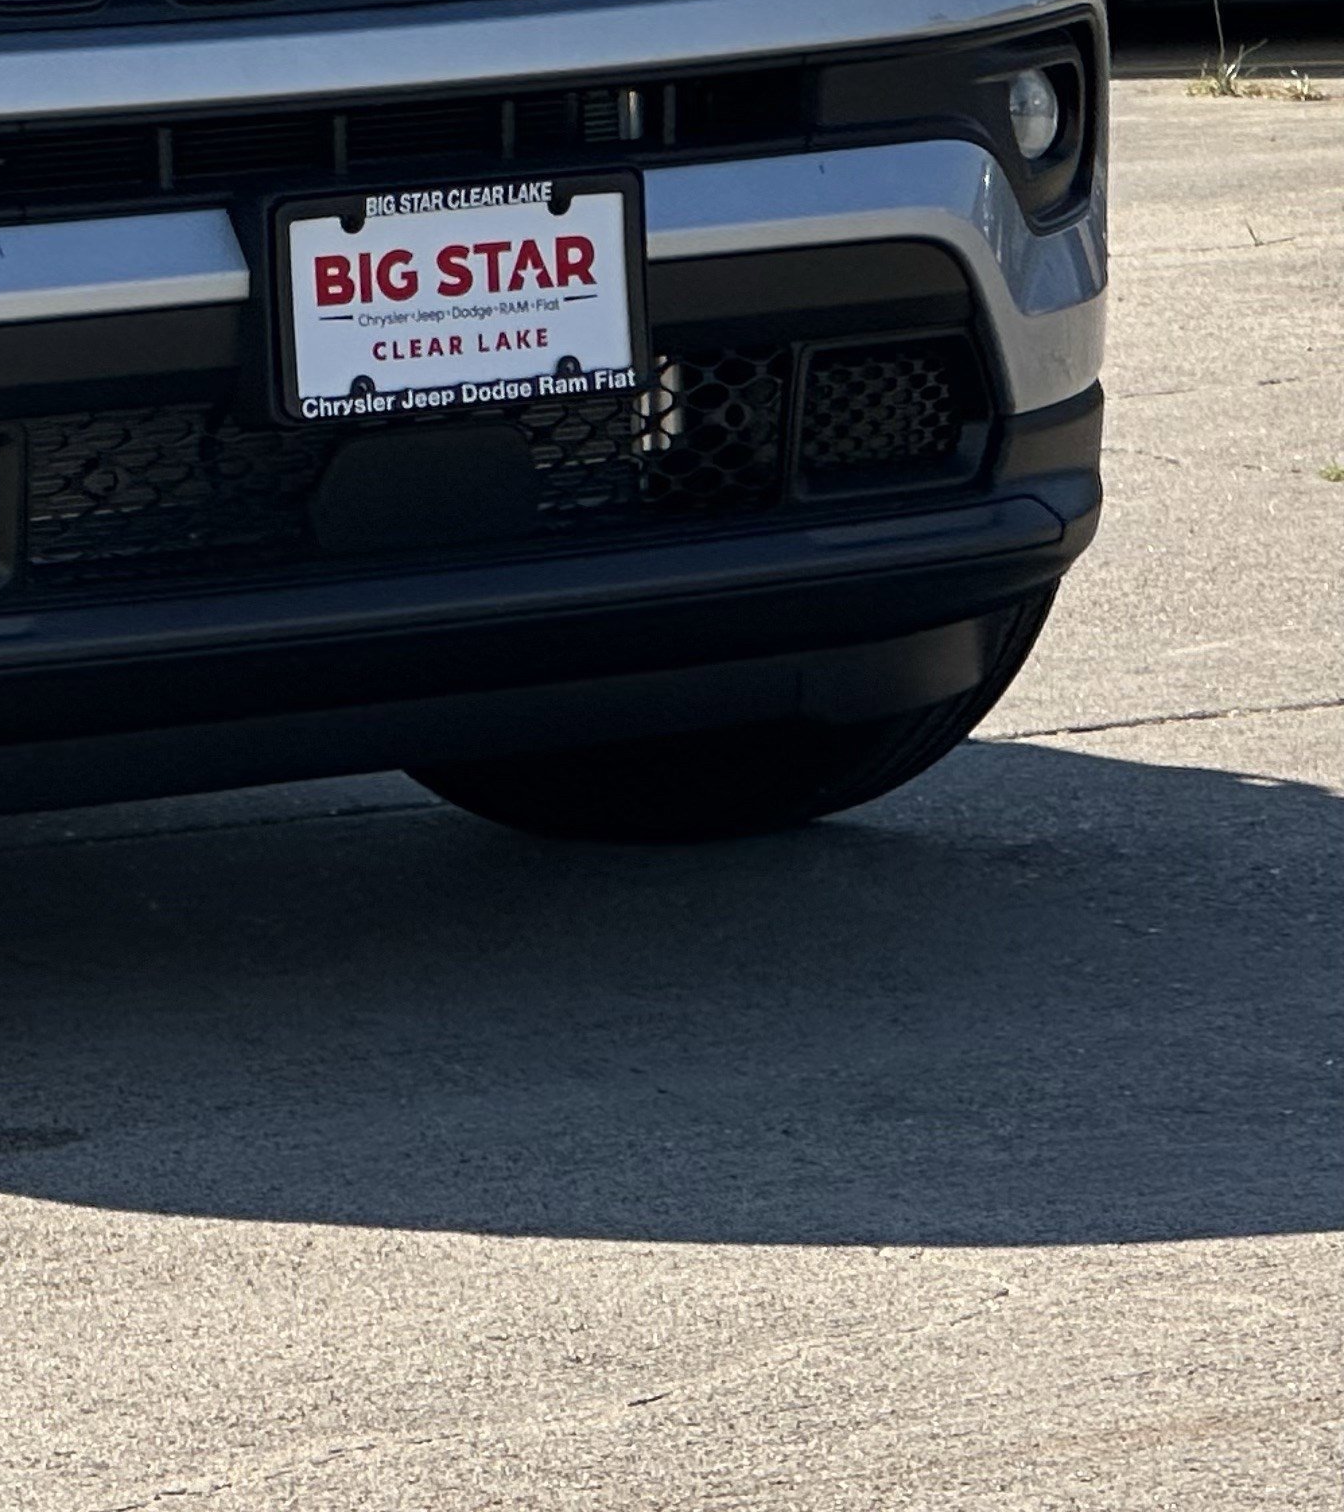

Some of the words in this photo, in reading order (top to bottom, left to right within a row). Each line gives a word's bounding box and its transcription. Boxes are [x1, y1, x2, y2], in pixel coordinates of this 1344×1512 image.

[365, 194, 397, 217] BIG
[399, 190, 444, 214] STAR
[447, 185, 505, 211] CLEAR
[507, 180, 554, 205] LAKE
[314, 248, 419, 307] BIG
[436, 235, 599, 299] STAR
[372, 334, 464, 361] CLEAR
[477, 327, 549, 353] LAKE
[301, 392, 396, 419] Chrysler
[401, 387, 455, 410] Jeep
[461, 377, 532, 404] Dodge
[538, 373, 588, 396] Ram
[594, 367, 637, 390] Fiat
